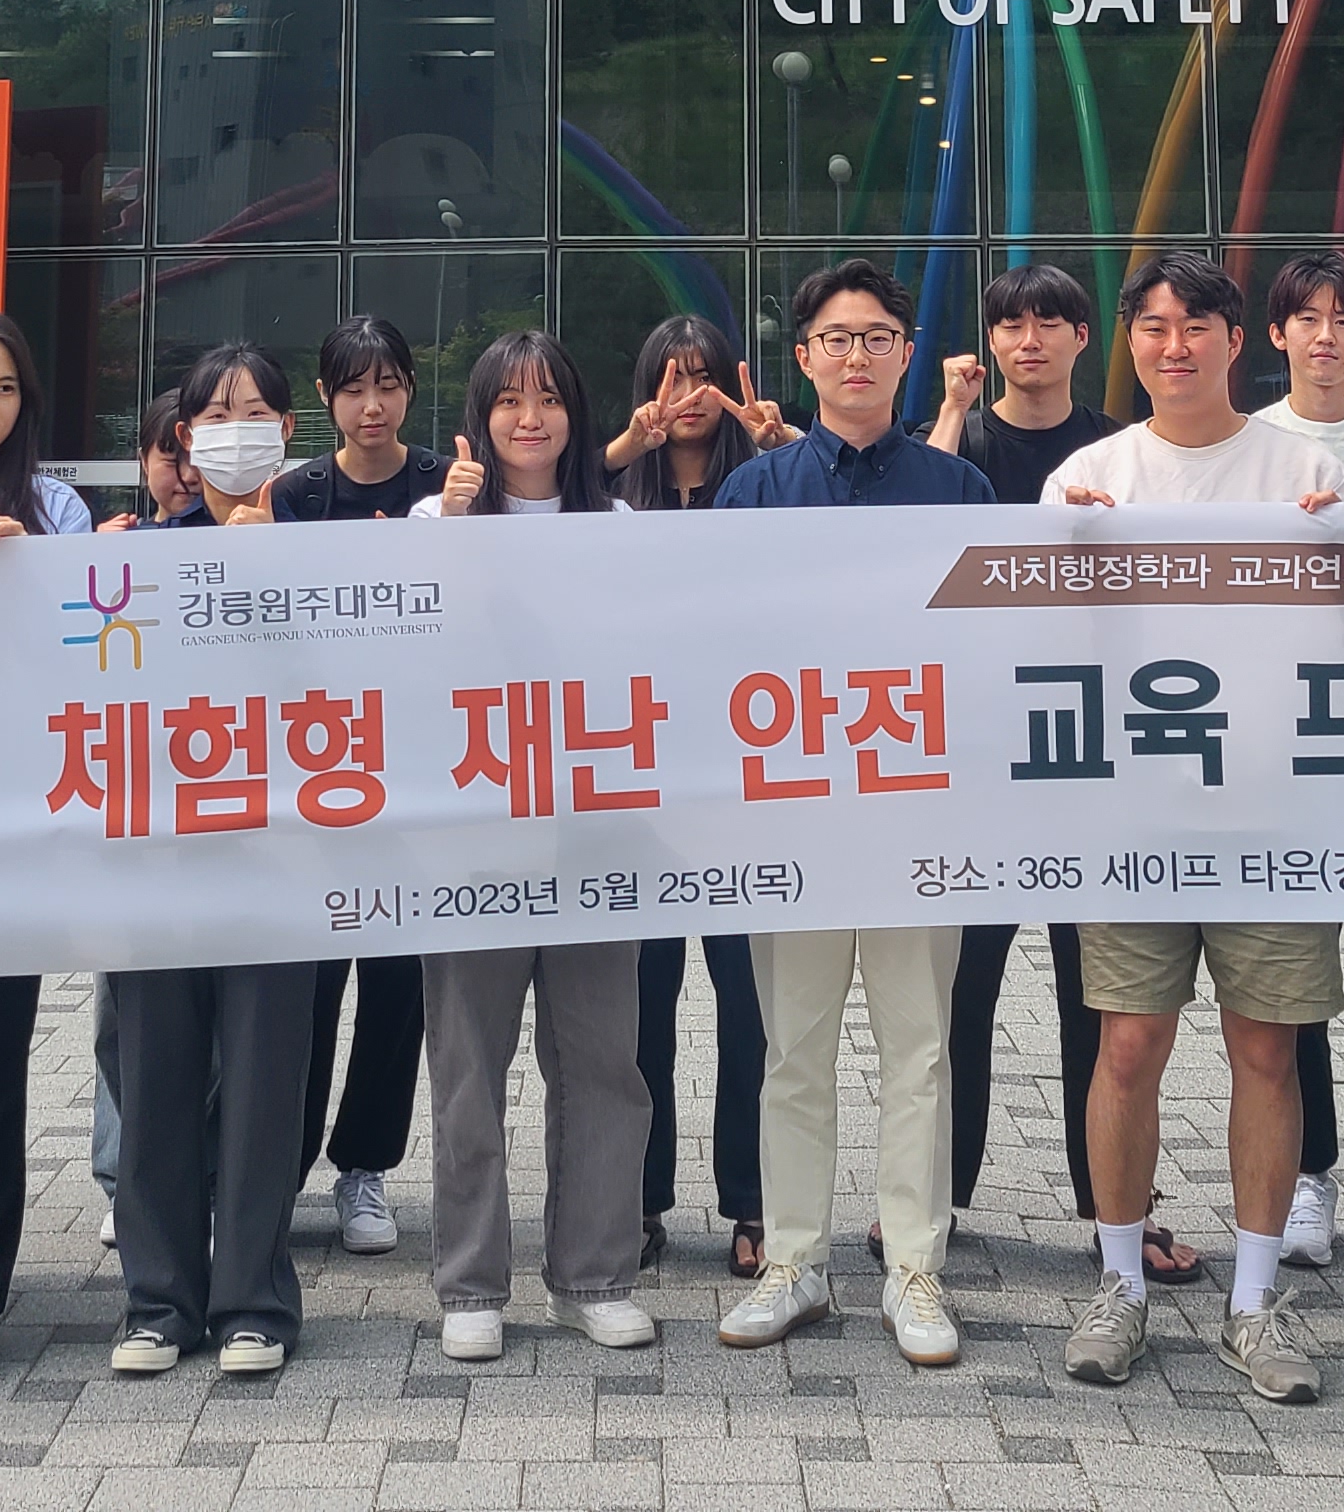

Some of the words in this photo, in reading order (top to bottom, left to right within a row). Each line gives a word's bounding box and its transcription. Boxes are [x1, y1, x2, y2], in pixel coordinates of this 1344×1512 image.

[177, 561, 226, 586] 국립
[981, 553, 1212, 592] 자치행정학과
[177, 582, 443, 629] 강릉원주대학교
[181, 630, 304, 647] GANGNEUNG-WONJU
[306, 627, 369, 640] NATIONAL
[371, 623, 443, 637] UNIVERSITY
[45, 689, 387, 839] 체험형
[450, 675, 669, 819] 재난
[729, 663, 950, 802] 안전
[1009, 657, 1229, 788] 교육
[432, 876, 559, 918] 2023년
[578, 871, 640, 912] 5월
[657, 860, 804, 906] 25일(목)
[1016, 856, 1083, 891] 365
[1101, 850, 1222, 893] 세이프
